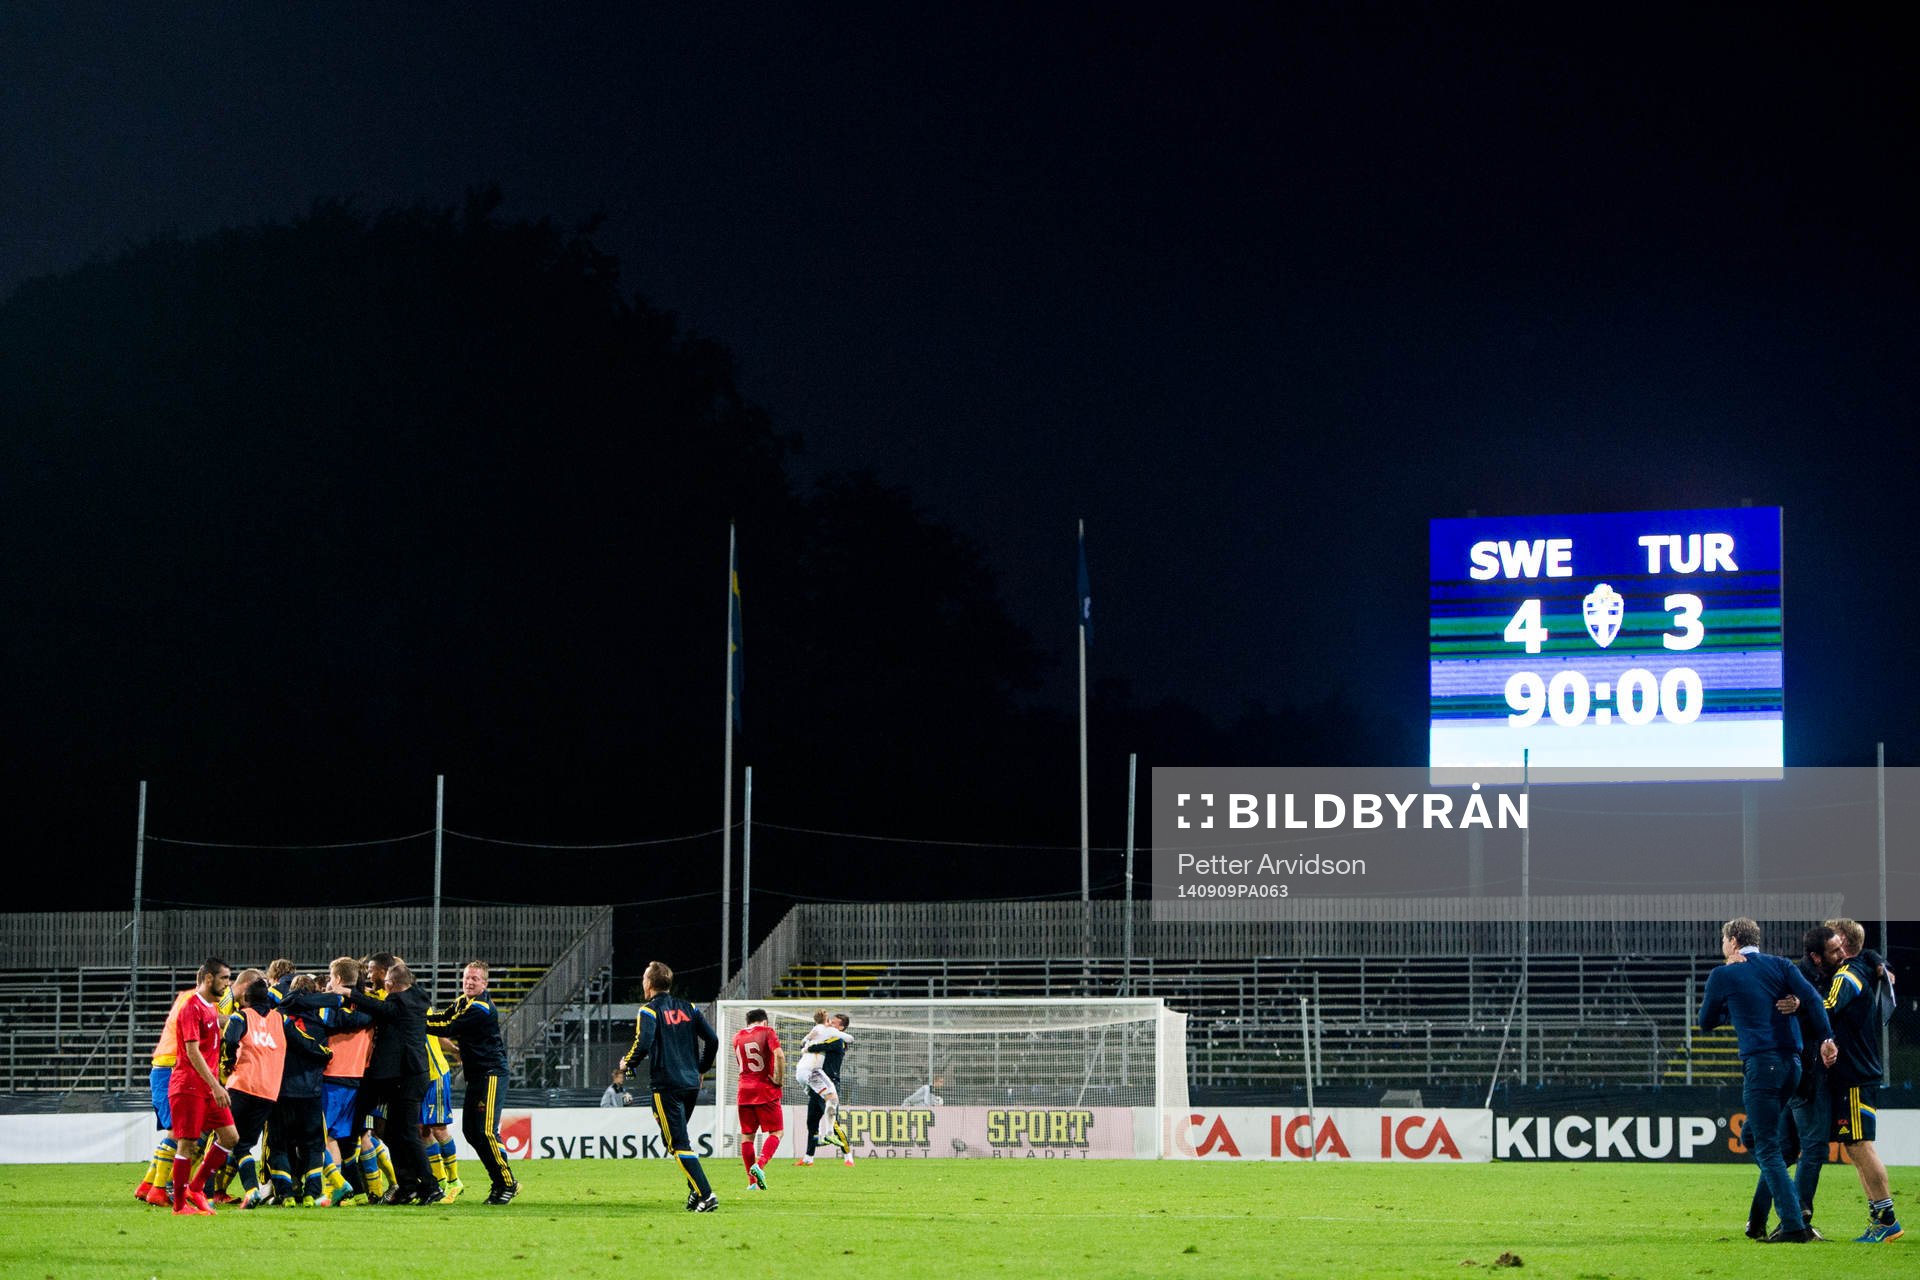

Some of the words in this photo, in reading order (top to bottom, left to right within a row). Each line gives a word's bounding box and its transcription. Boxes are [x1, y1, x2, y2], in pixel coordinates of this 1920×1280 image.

[1469, 538, 1573, 580] SWE
[1638, 533, 1739, 574] TUR
[1503, 599, 1548, 654] 4
[1662, 593, 1704, 650] 3
[1504, 667, 1704, 728] 90:00
[664, 1009, 691, 1025] ICA
[253, 1031, 277, 1050] ICA
[428, 1104, 435, 1119] 7
[987, 1110, 1094, 1147] SPORT
[540, 1136, 672, 1159] SVENSK
[1271, 1114, 1351, 1159] ICA
[1381, 1115, 1463, 1160] ICA
